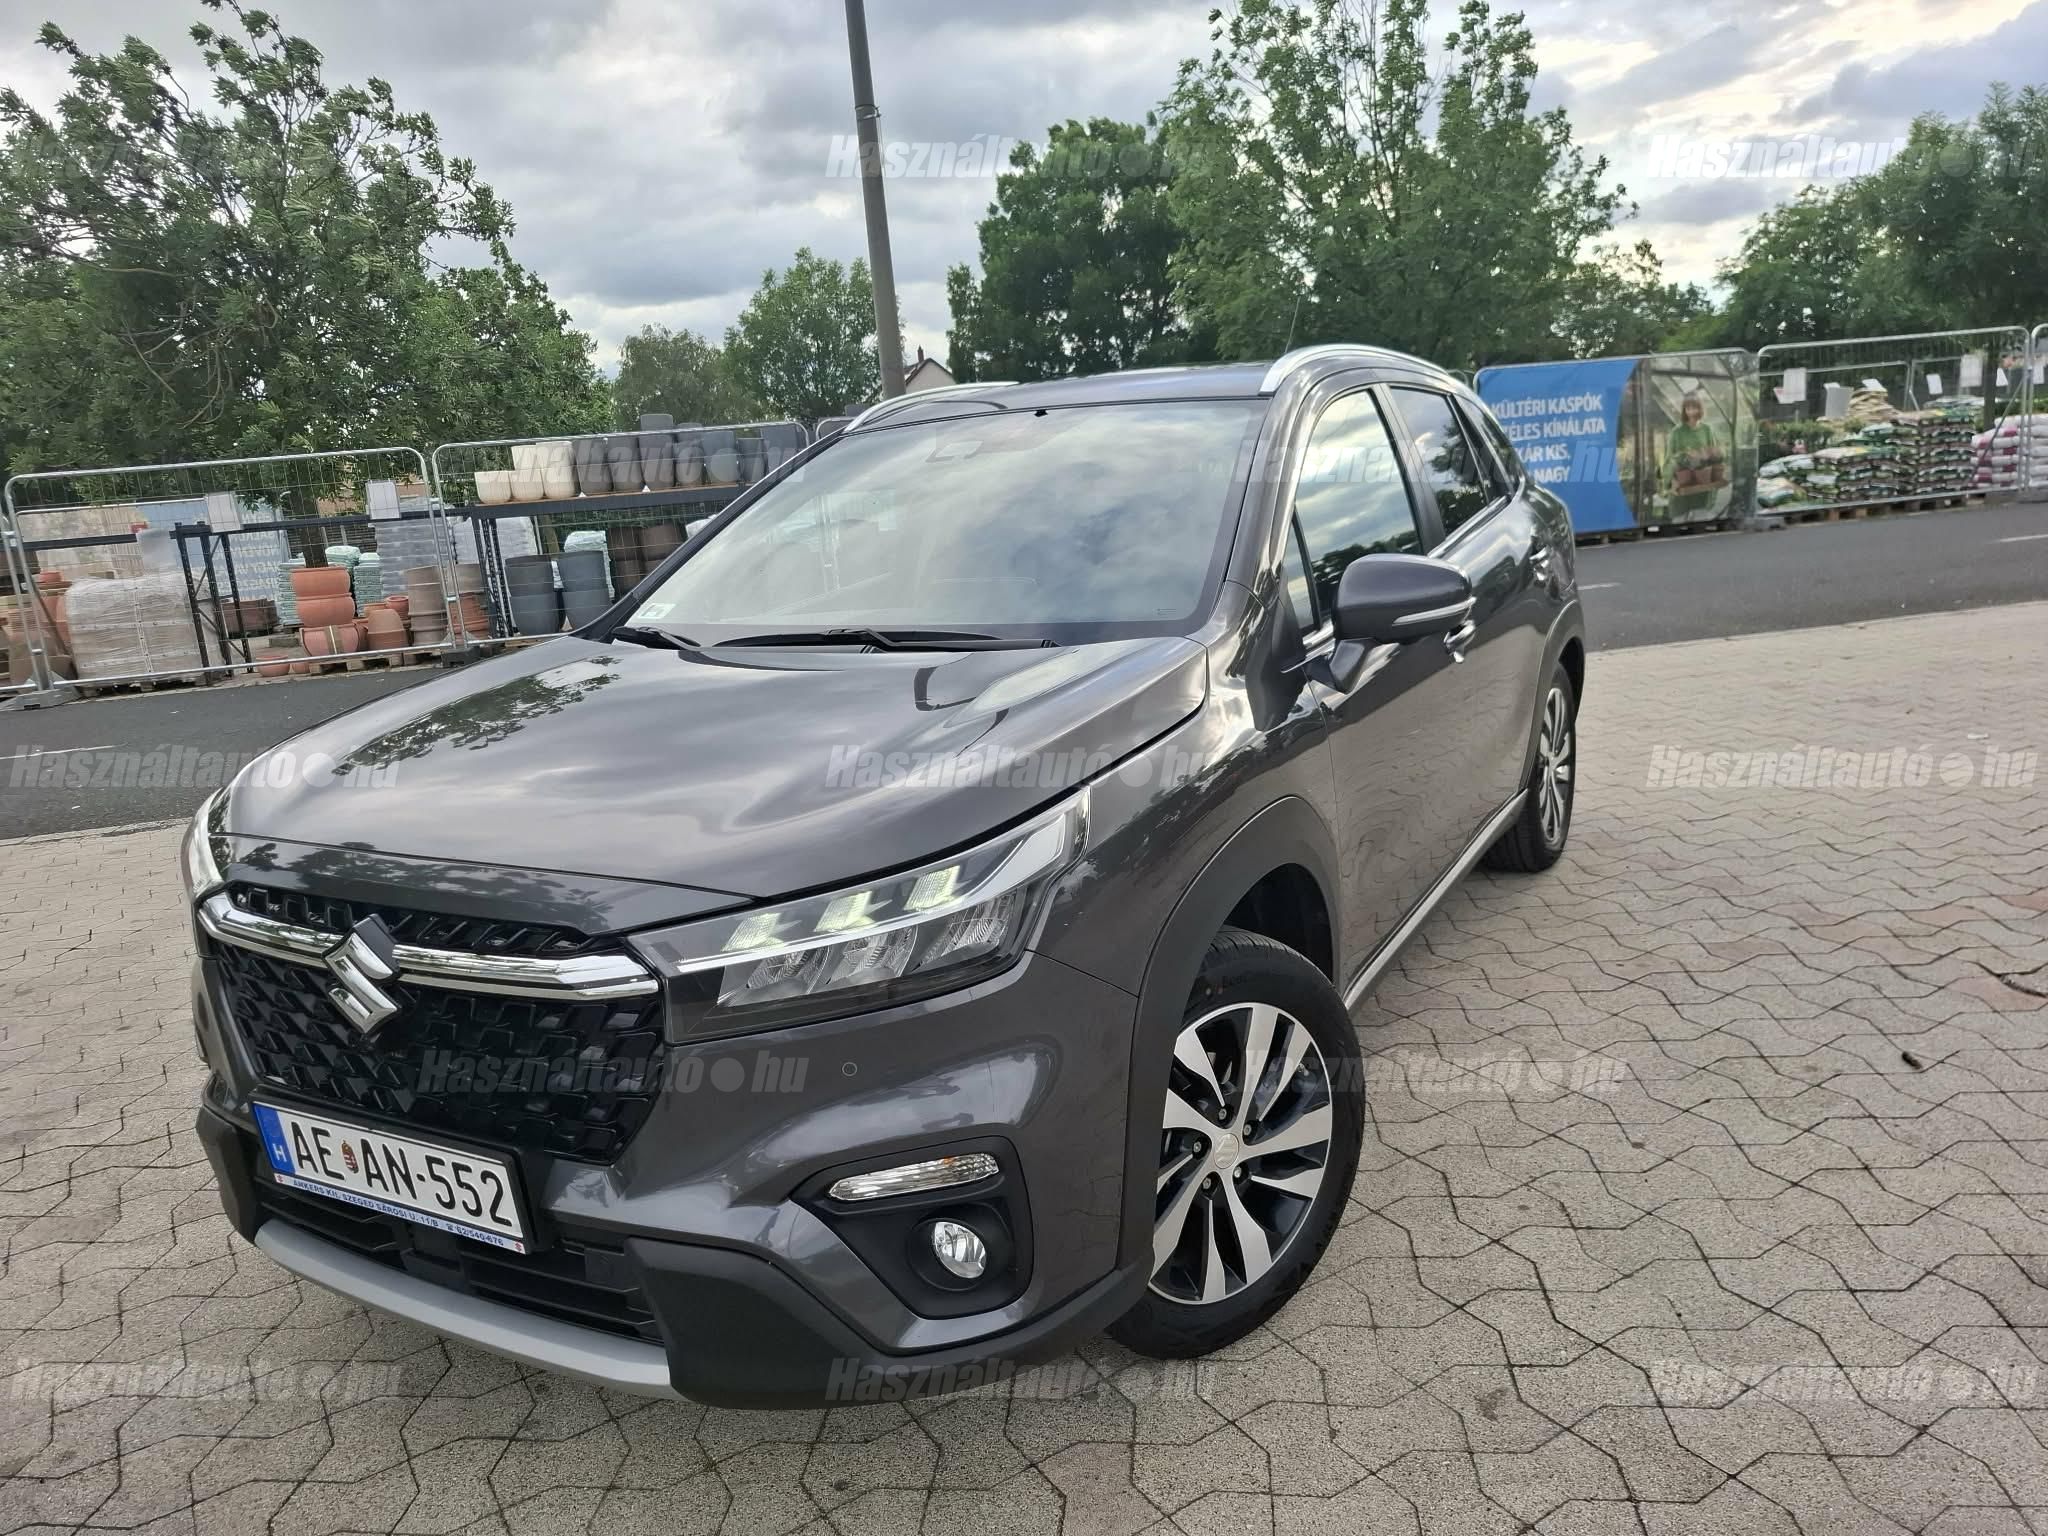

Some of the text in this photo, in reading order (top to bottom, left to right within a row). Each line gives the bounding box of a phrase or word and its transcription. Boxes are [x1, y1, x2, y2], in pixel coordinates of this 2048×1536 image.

[1548, 391, 1603, 414] KASPÓK
[1543, 416, 1606, 438] KÍNÁLATA
[1533, 466, 1570, 484] NAGY
[272, 1143, 287, 1163] H
[290, 1121, 512, 1227] AE AN-552
